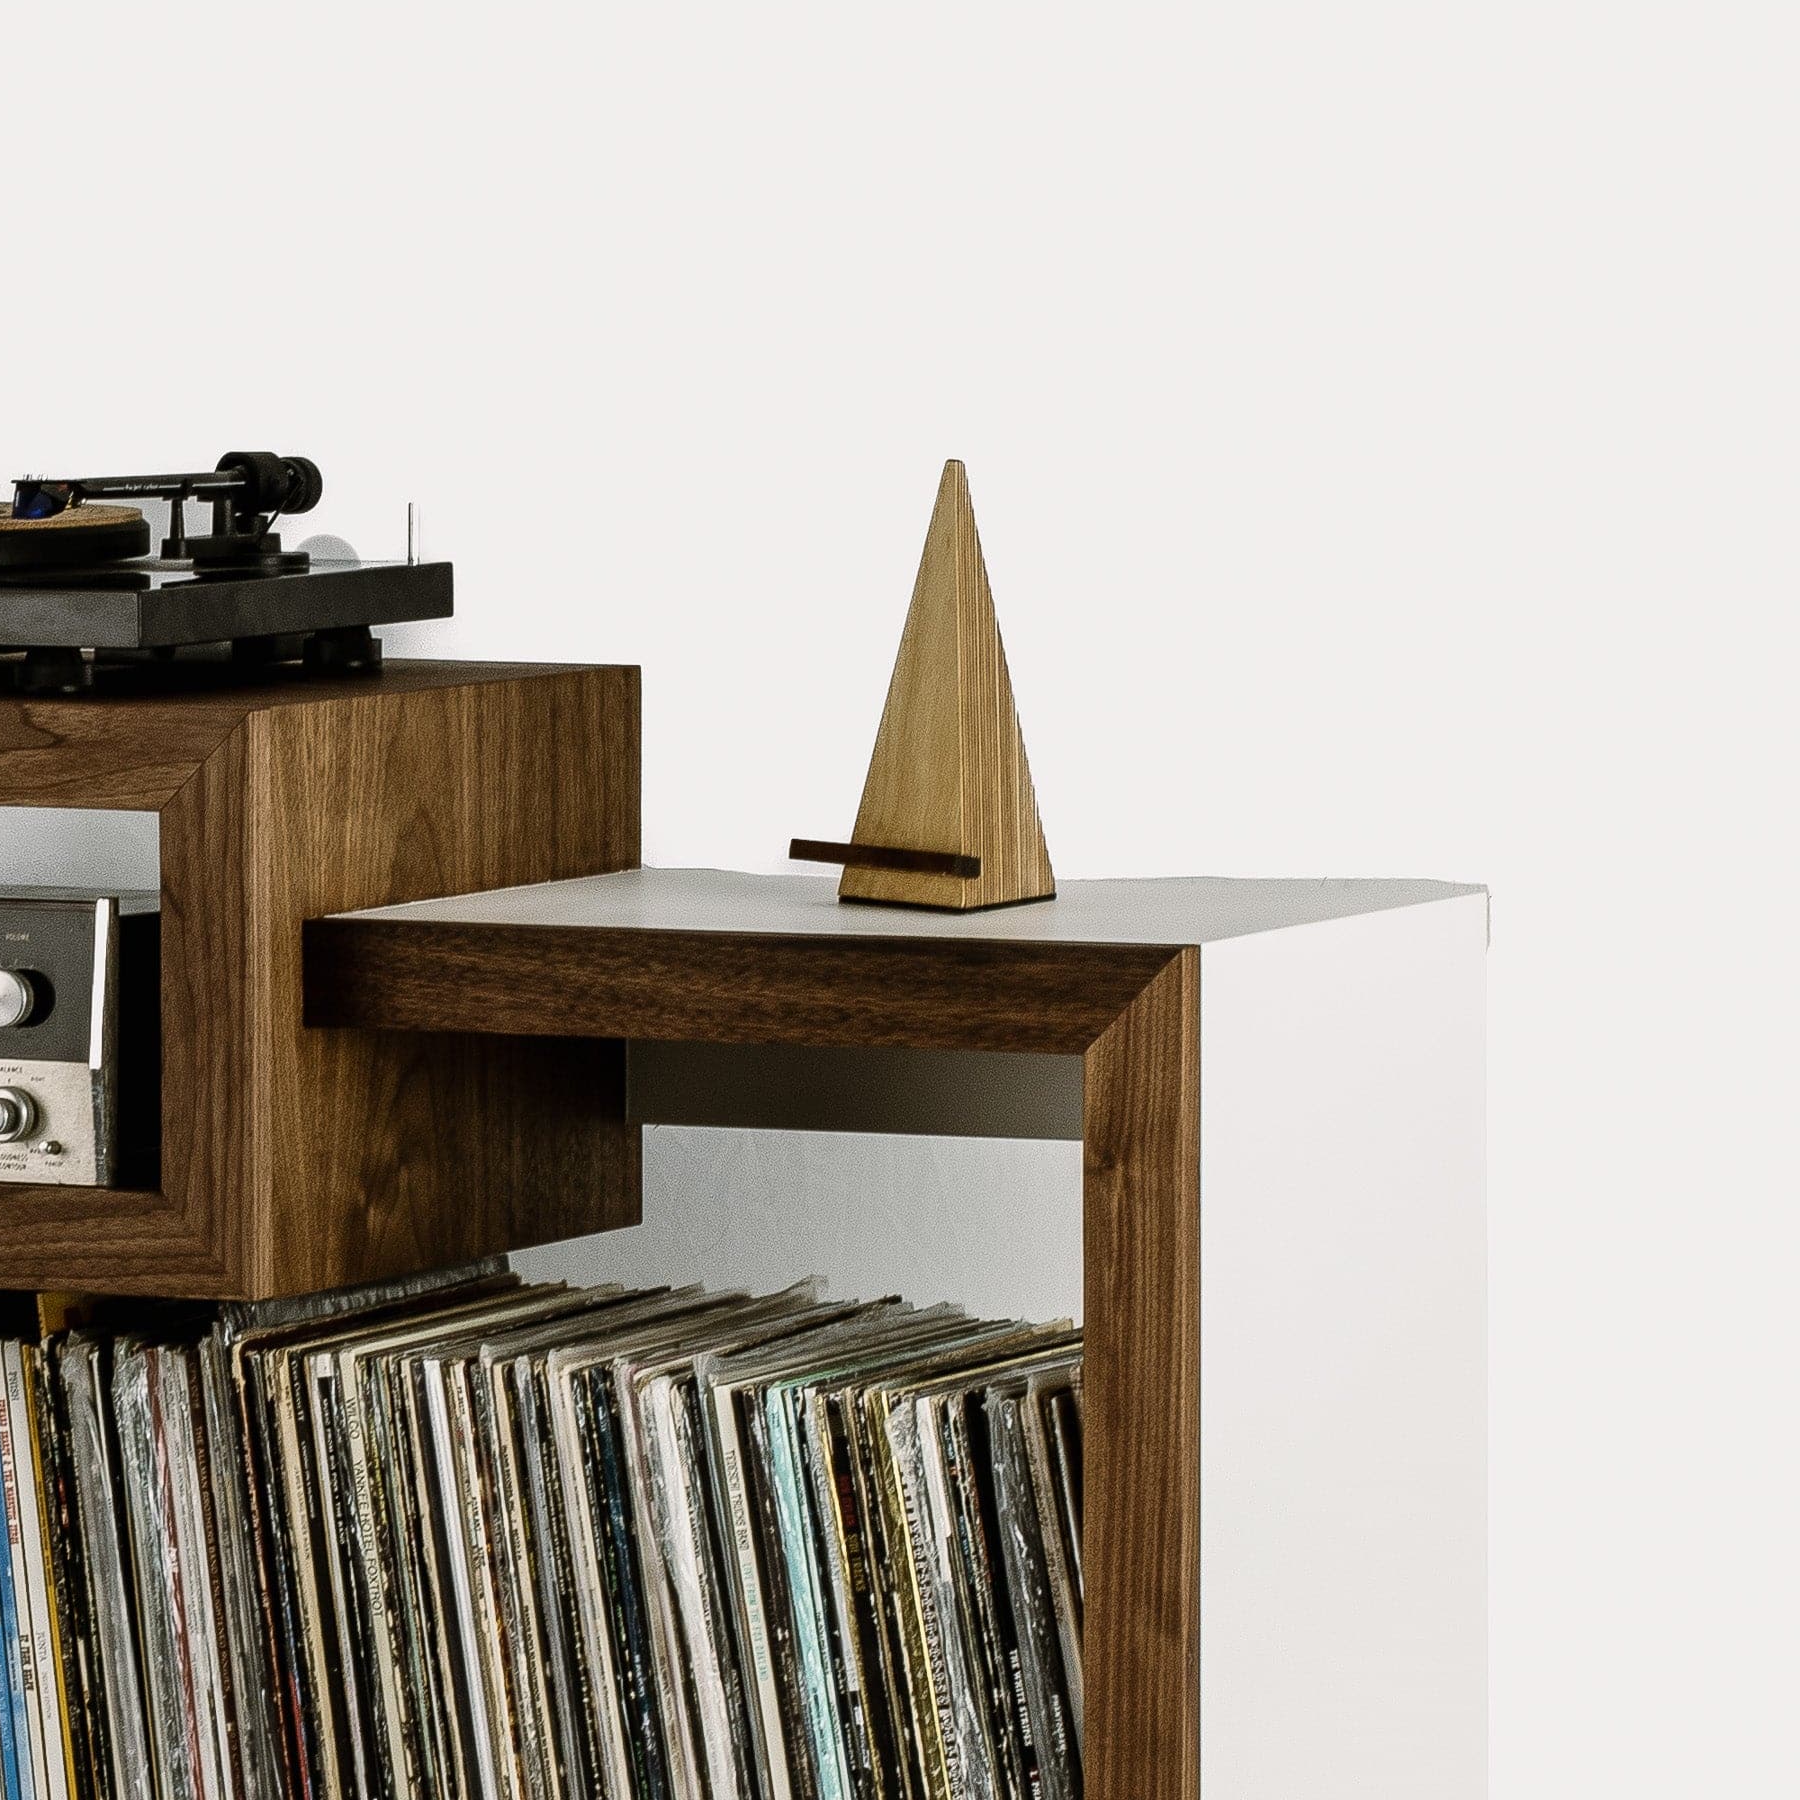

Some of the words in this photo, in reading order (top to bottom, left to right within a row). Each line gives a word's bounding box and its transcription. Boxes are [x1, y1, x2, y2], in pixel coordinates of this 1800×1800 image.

[8, 1371, 19, 1400] PHISH
[344, 1397, 360, 1439] WILCO
[196, 1448, 209, 1488] ALLMAN
[352, 1460, 369, 1509] YANKEE
[724, 1449, 740, 1490] TEDESCHI
[730, 1494, 745, 1526] TRUCKS
[359, 1513, 375, 1554] HOTEL
[735, 1529, 748, 1551] BAND
[365, 1558, 383, 1617] FOXTROT
[850, 1557, 866, 1592] TRACKS
[35, 1631, 47, 1662] JUNTA
[1008, 1648, 1021, 1669] THE
[1012, 1670, 1026, 1704] WHITE
[1017, 1705, 1032, 1746] STRIPES
